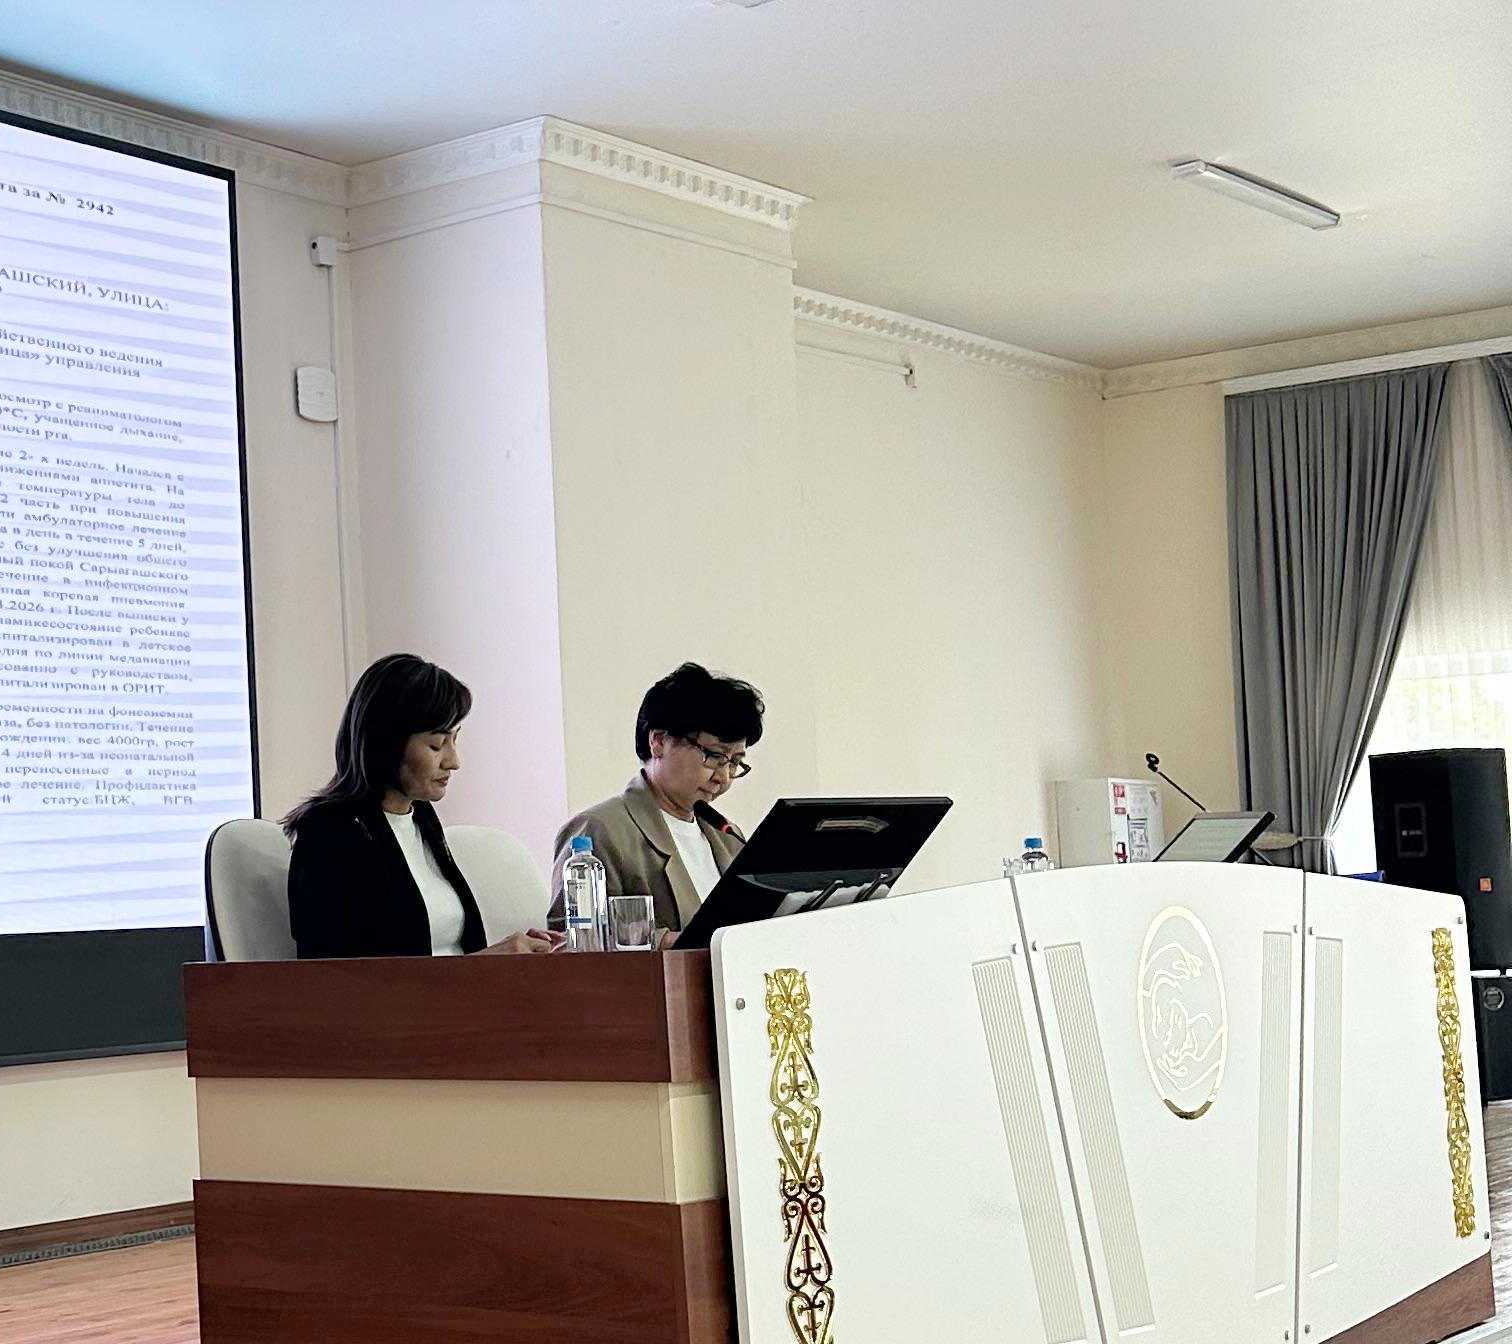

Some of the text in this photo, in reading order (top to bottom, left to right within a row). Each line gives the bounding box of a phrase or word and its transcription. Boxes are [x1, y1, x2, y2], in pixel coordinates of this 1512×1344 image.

[25, 188, 41, 199] за
[45, 191, 66, 205] №
[76, 198, 114, 216] 2942
[97, 286, 168, 311] УЛИЦА:
[45, 354, 141, 379] управления
[99, 348, 163, 368] ведения
[34, 413, 114, 432] учащенное
[67, 403, 182, 428] реаниматологом
[18, 483, 113, 502] температуры
[166, 484, 185, 496] На
[20, 497, 61, 511] часть
[70, 504, 97, 515] при
[107, 508, 186, 525] повышения
[23, 513, 125, 532] амбулаторное
